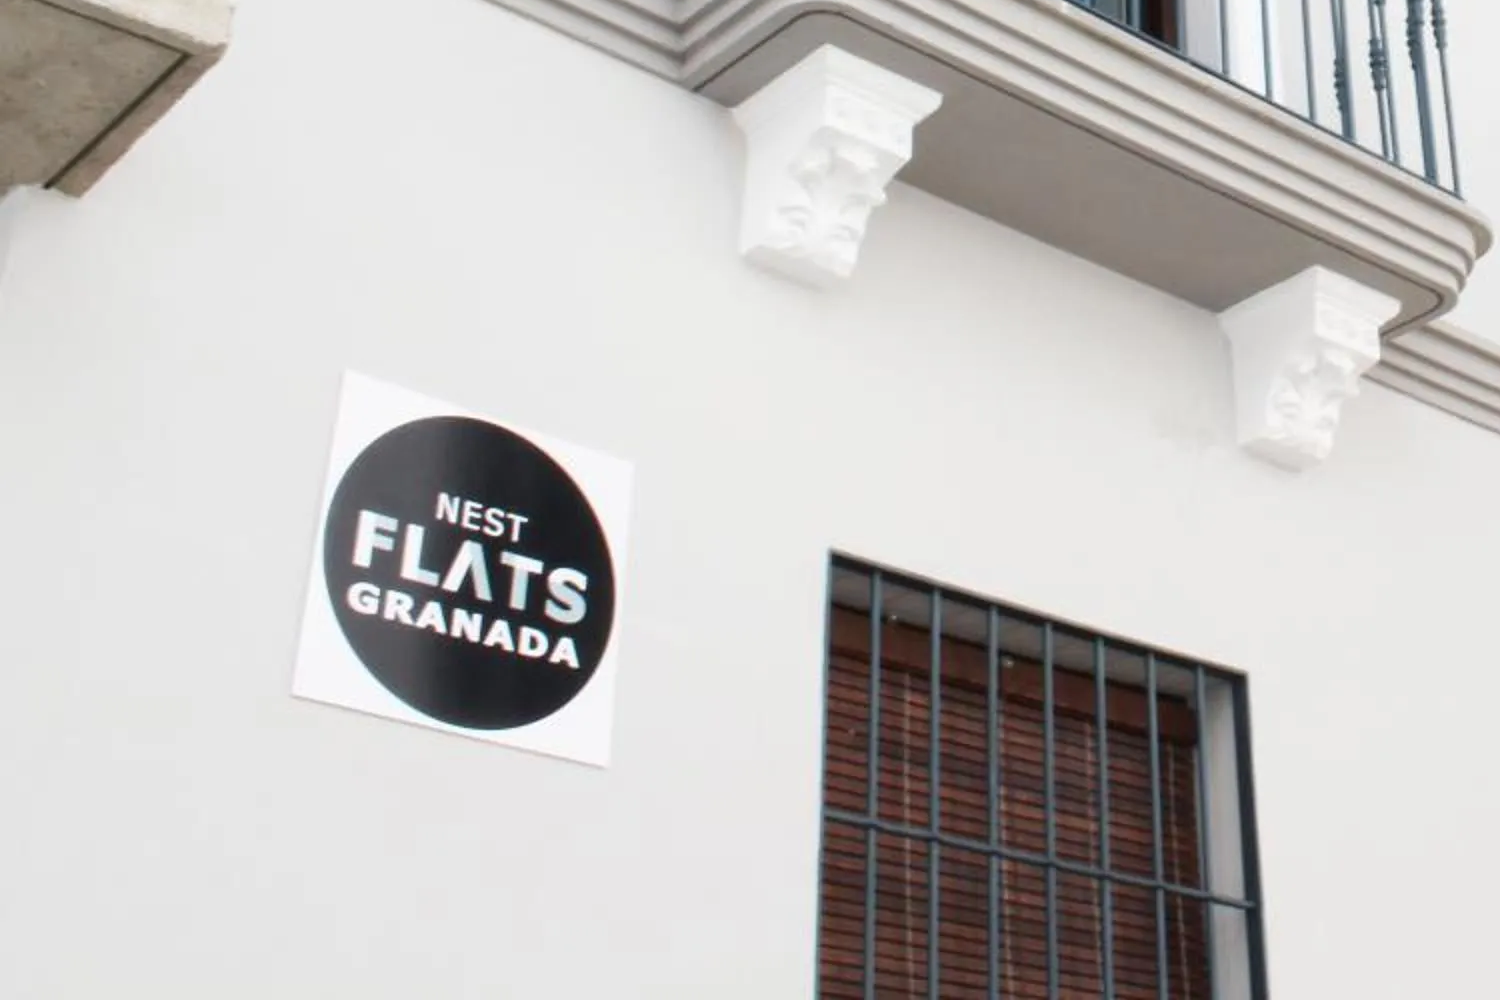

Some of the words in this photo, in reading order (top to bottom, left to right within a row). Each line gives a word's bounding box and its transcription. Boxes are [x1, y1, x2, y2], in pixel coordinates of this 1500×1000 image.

[434, 491, 530, 544] NEST
[350, 507, 590, 626] FLATS
[345, 580, 582, 670] GRANADA
